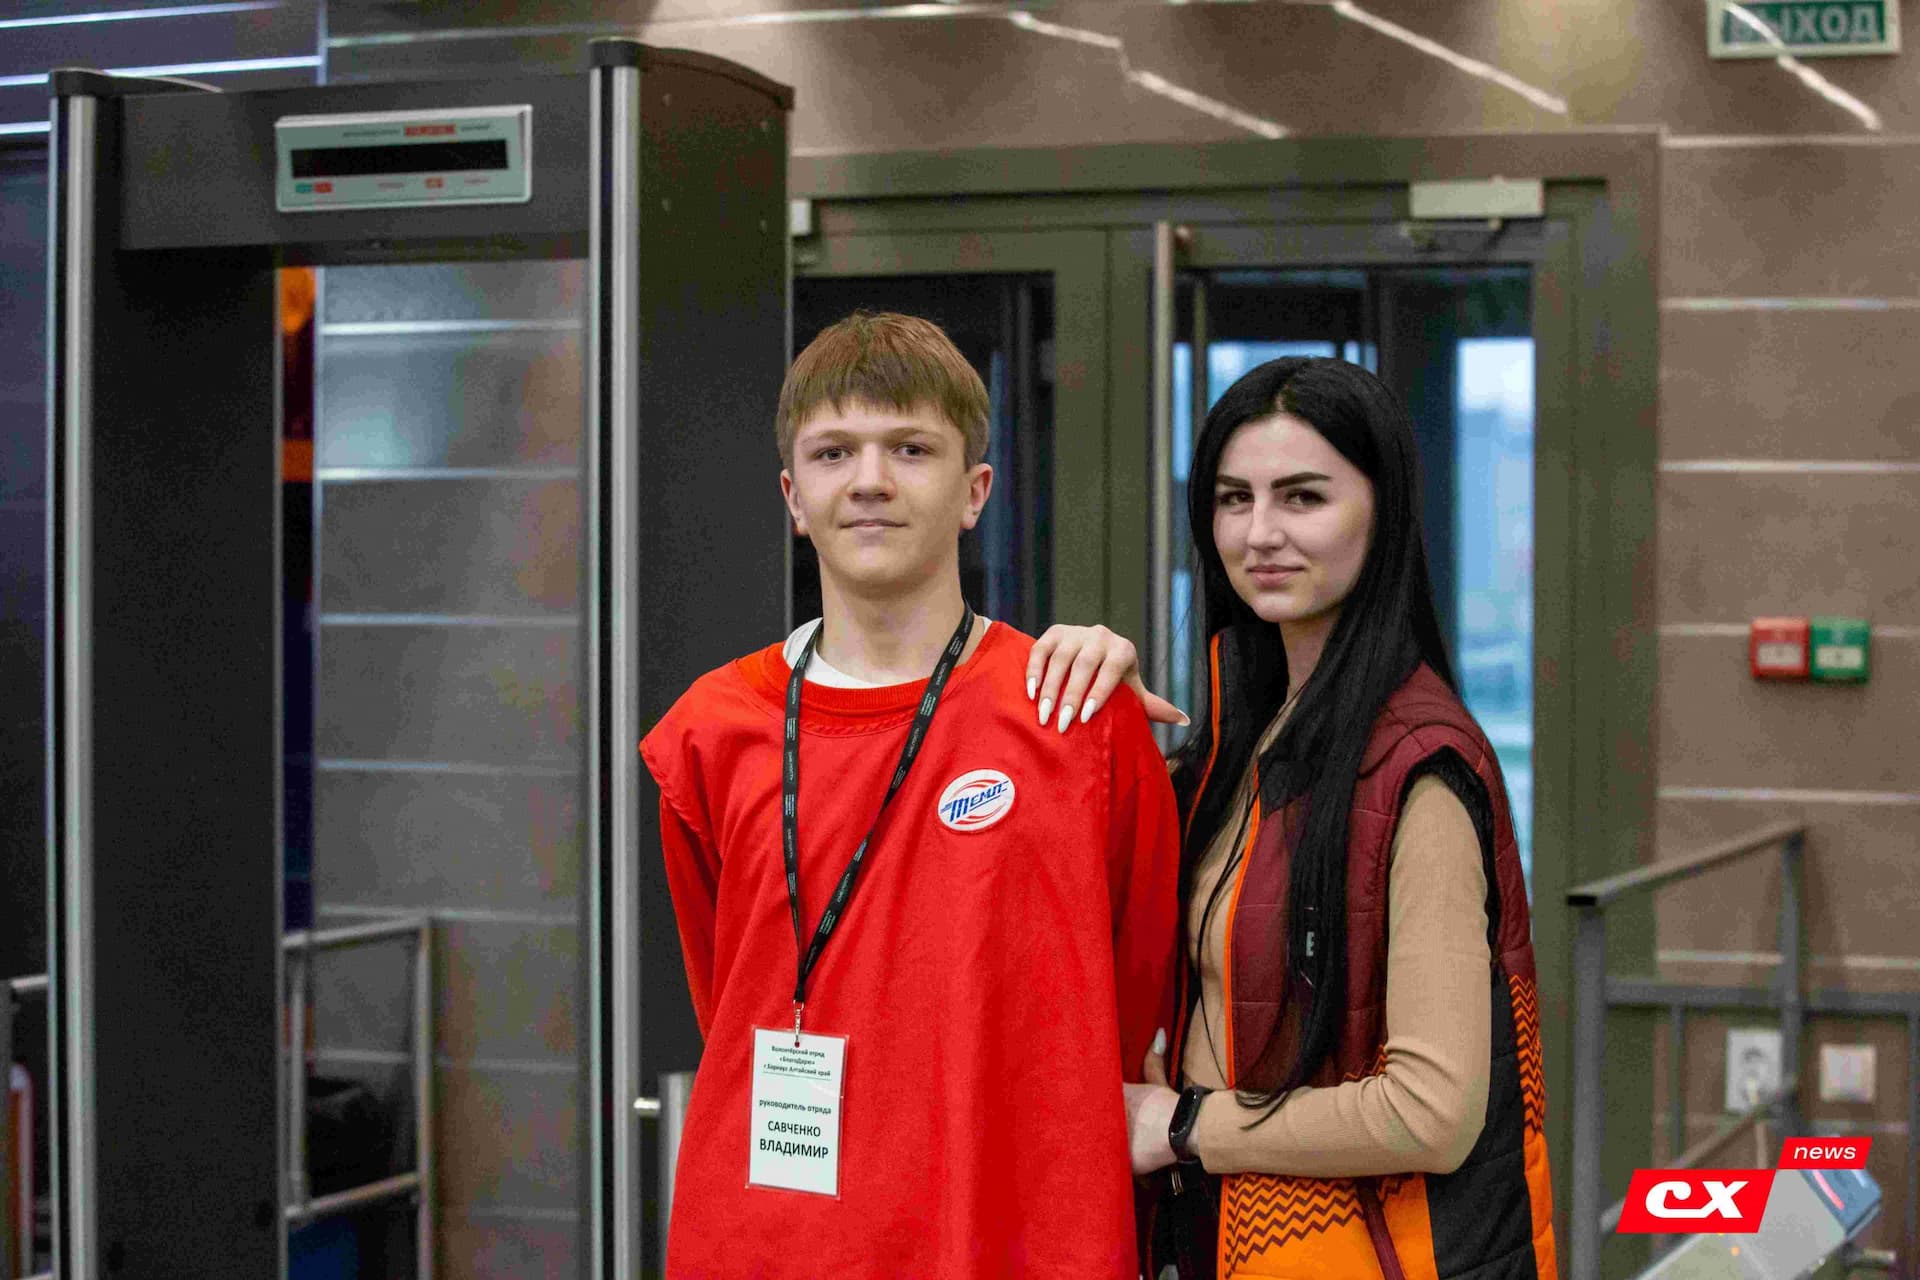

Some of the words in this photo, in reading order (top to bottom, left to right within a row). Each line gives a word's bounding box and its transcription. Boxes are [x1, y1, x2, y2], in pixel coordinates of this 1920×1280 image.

[759, 1099, 806, 1111] руководитель
[807, 1106, 832, 1115] отряда
[767, 1120, 821, 1137] САВЧЕНКО
[760, 1138, 829, 1159] ВЛАДИМИР
